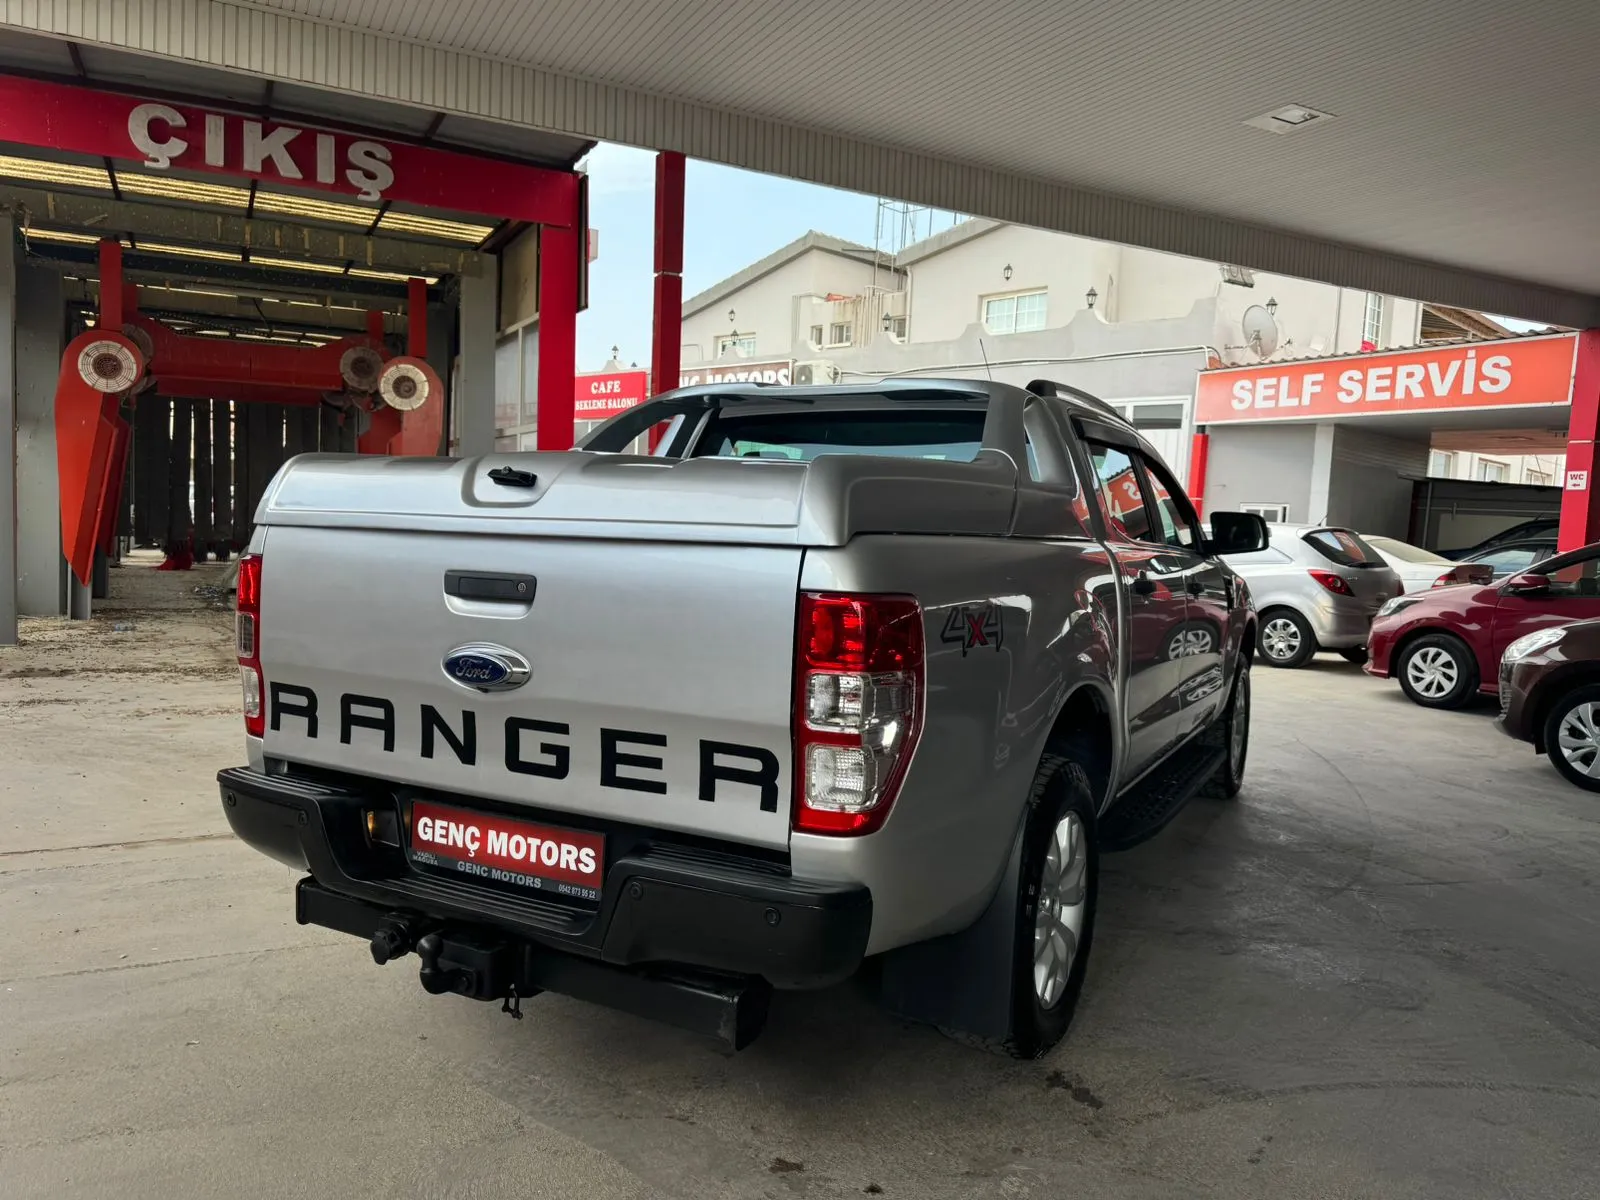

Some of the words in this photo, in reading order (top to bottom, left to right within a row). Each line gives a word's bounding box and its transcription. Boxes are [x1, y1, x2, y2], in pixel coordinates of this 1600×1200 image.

[128, 103, 394, 201] ÇIKIŞ
[591, 380, 621, 394] CAFE
[1231, 372, 1324, 410] SELF
[1336, 350, 1512, 404] SERVİS
[608, 398, 638, 409] SALONU
[455, 657, 493, 680] Ford
[270, 681, 780, 813] RANGER
[417, 816, 481, 857] GENÇ
[487, 829, 596, 874] MOTORS
[457, 861, 489, 877] GENC
[491, 870, 542, 888] MOTORS
